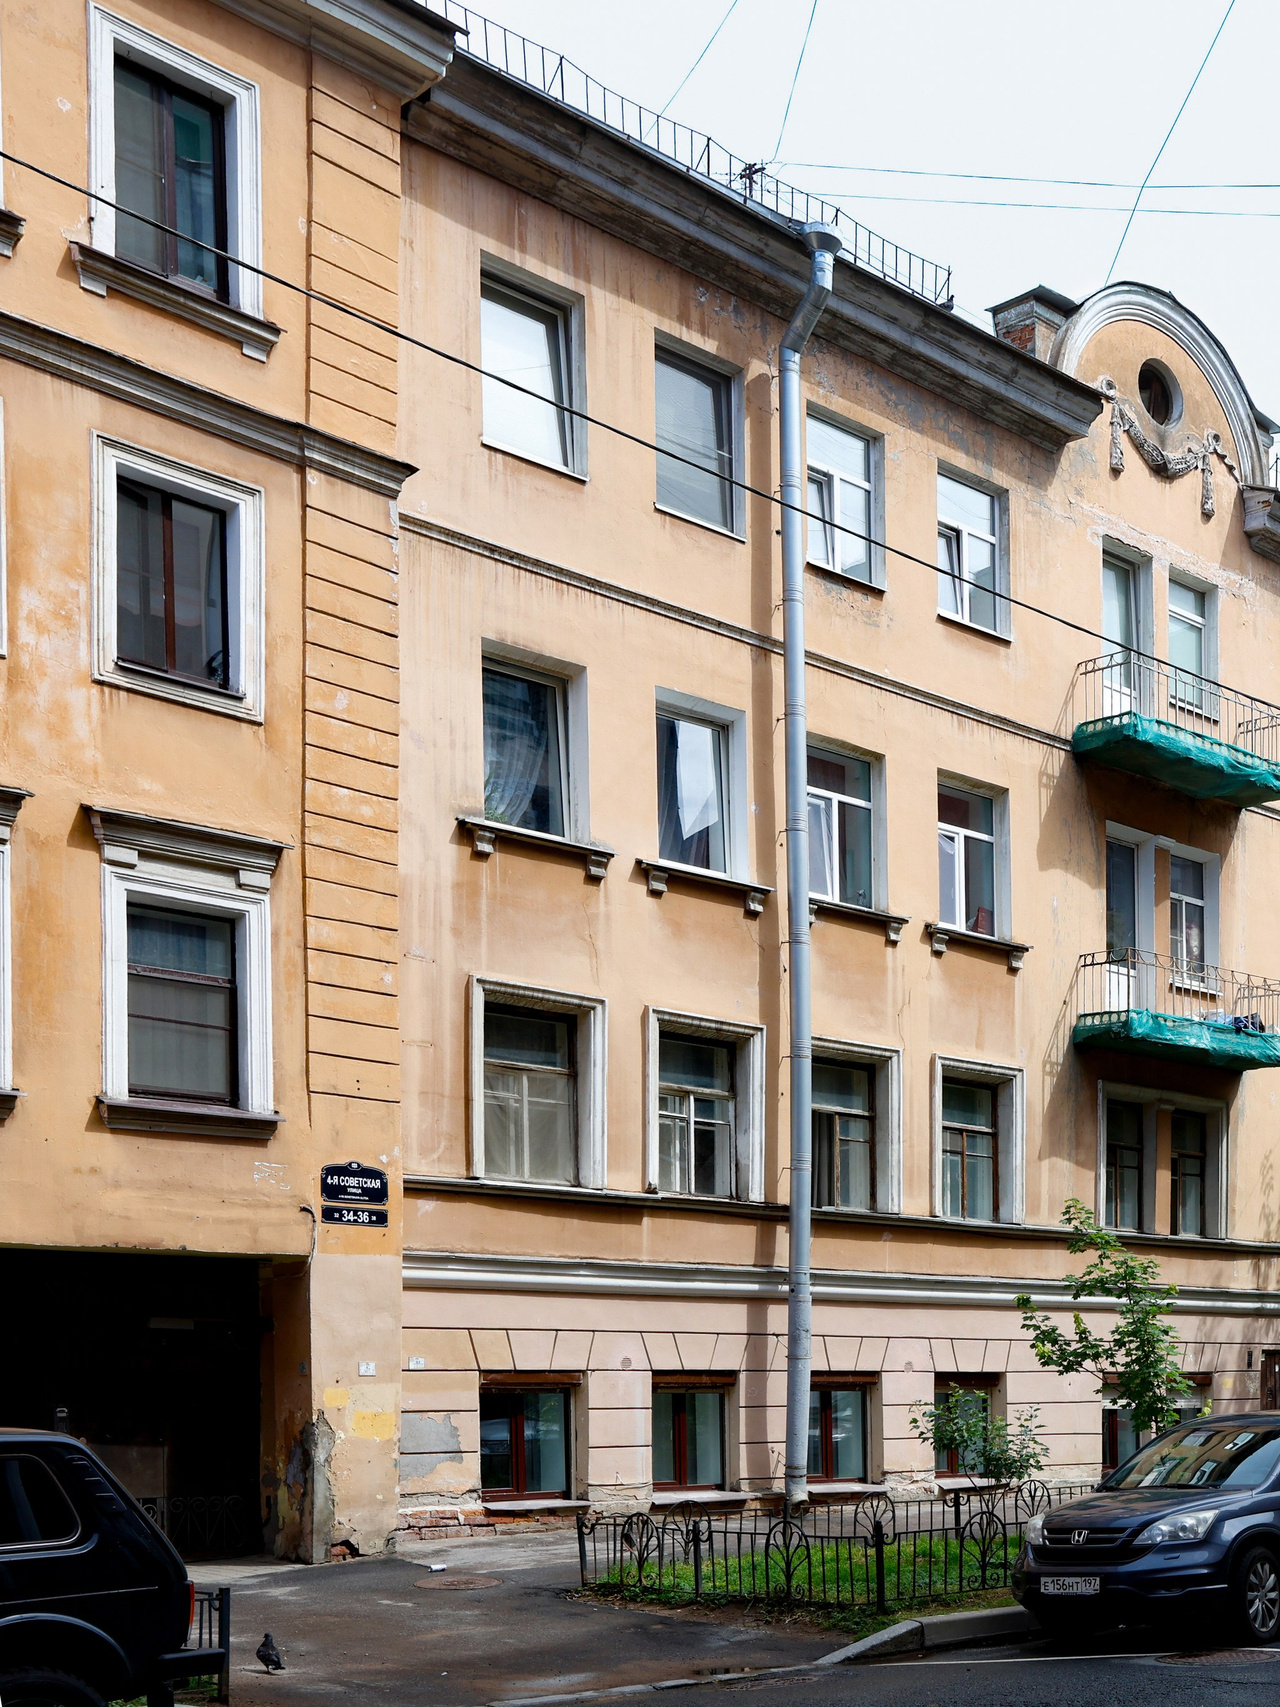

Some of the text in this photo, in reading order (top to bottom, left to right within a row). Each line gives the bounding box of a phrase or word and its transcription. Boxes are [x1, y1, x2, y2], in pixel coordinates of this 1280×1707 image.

[327, 1175, 381, 1189] 4-Я СОВЕТСКАЯ
[341, 1210, 370, 1223] 34-36
[1043, 1578, 1097, 1591] Е156НТ 197
